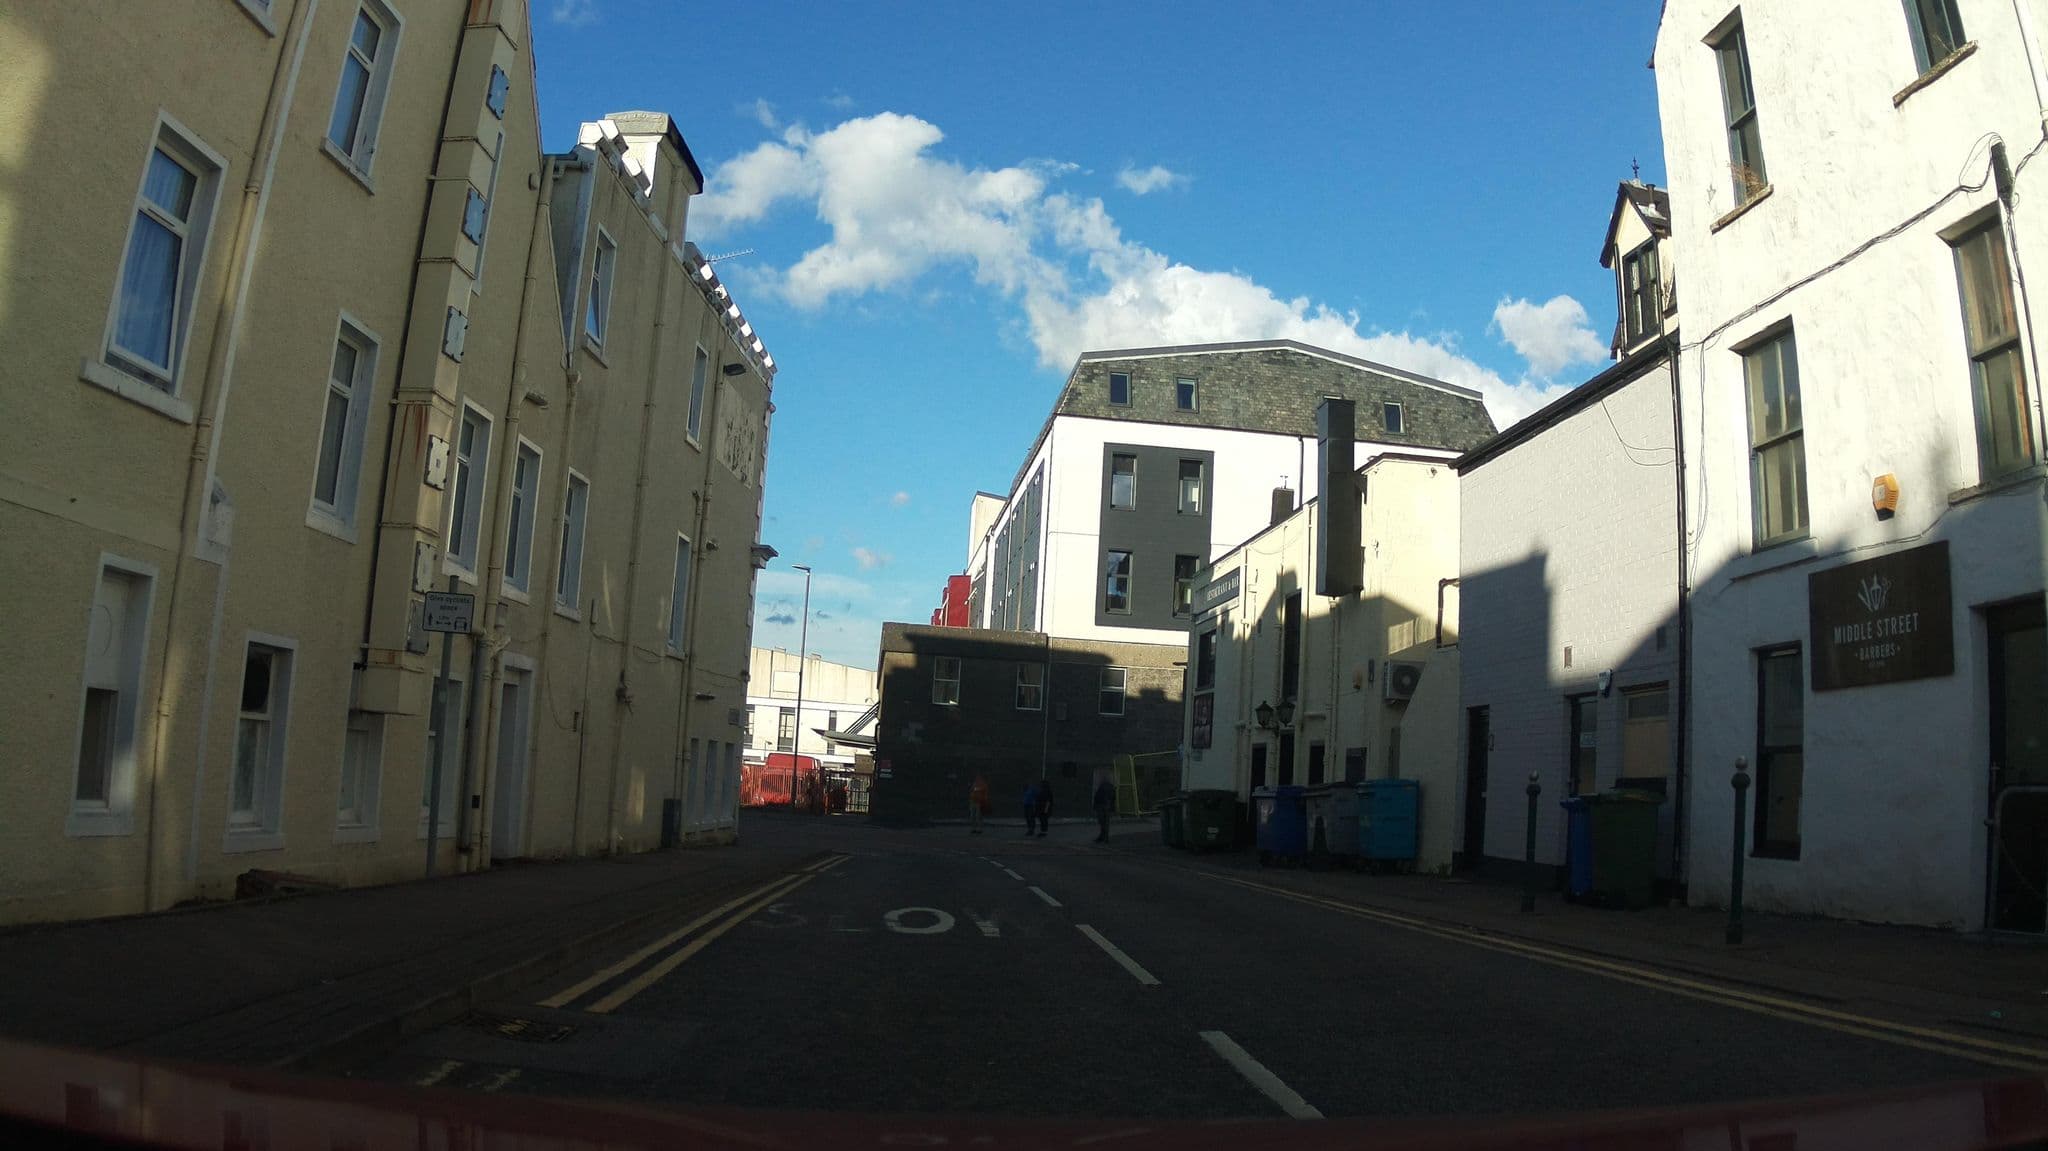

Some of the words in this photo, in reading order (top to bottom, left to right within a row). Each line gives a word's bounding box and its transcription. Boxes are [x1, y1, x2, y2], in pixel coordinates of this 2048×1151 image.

[1833, 622, 1873, 645] MIDDLE
[1876, 612, 1919, 638] STREET
[1859, 643, 1896, 661] BARBERS
